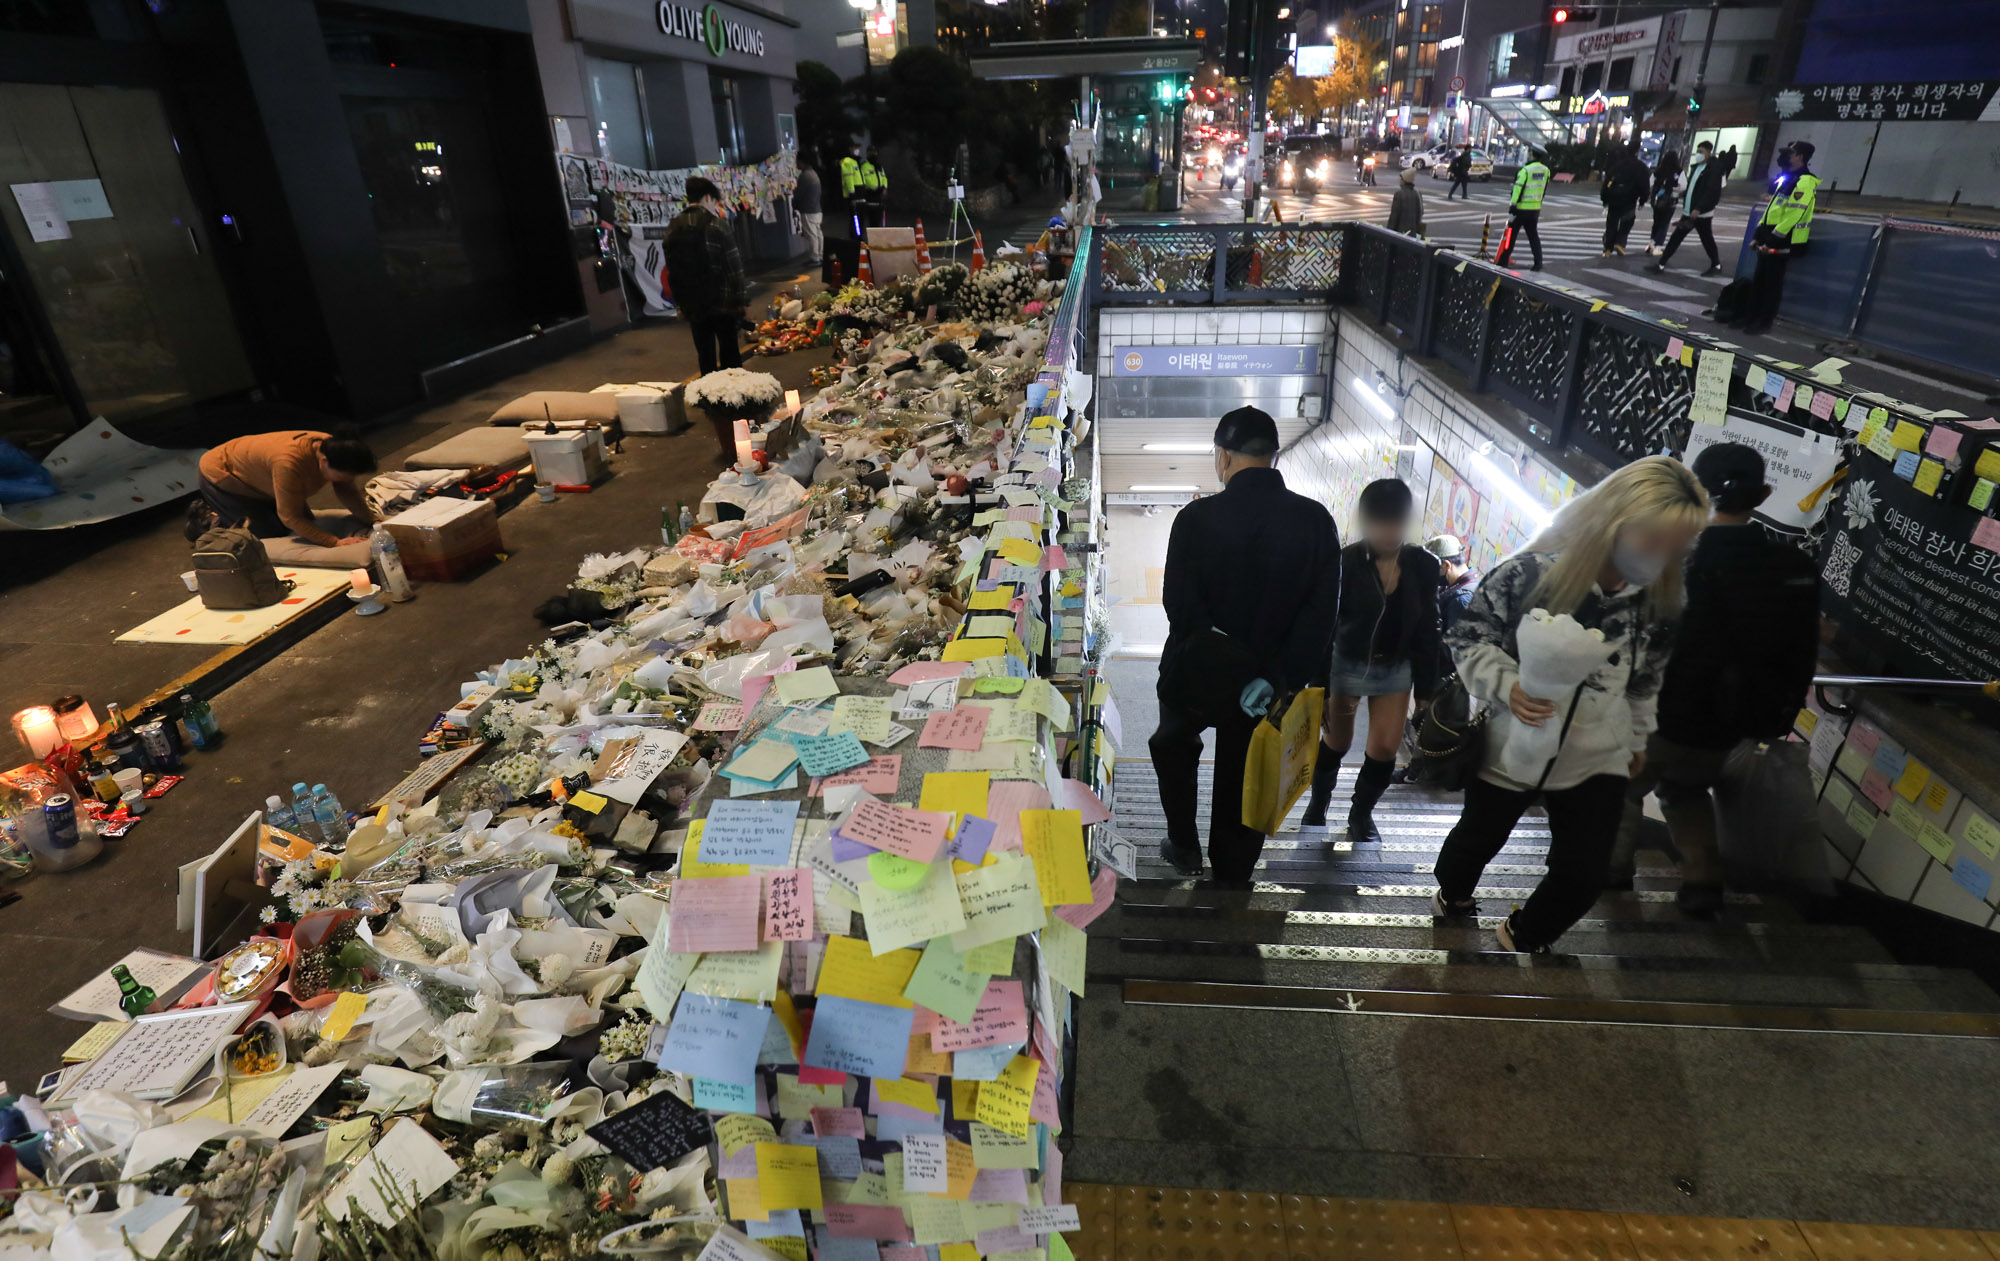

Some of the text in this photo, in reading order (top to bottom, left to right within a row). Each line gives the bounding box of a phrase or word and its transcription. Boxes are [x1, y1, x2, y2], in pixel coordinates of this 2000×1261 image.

[660, 0, 765, 57] OLIVE YOUNG
[1813, 82, 1985, 102] 이태원 참사 희생자의
[1837, 102, 1947, 119] 명복을 빕니다
[1126, 357, 1141, 366] 630
[1168, 352, 1212, 370] 이태원
[1217, 353, 1248, 361] Itaewon
[1298, 349, 1305, 363] 1
[1722, 430, 1789, 459] 이란인 다섯 분을 포함한
[1770, 460, 1791, 475] 명복을
[1792, 467, 1812, 481] 빕니다
[1884, 507, 1924, 546] 이태원
[1925, 531, 1967, 565] 참사
[1884, 536, 1910, 555] send
[1908, 550, 1924, 563] our
[1924, 559, 1970, 586] deepest
